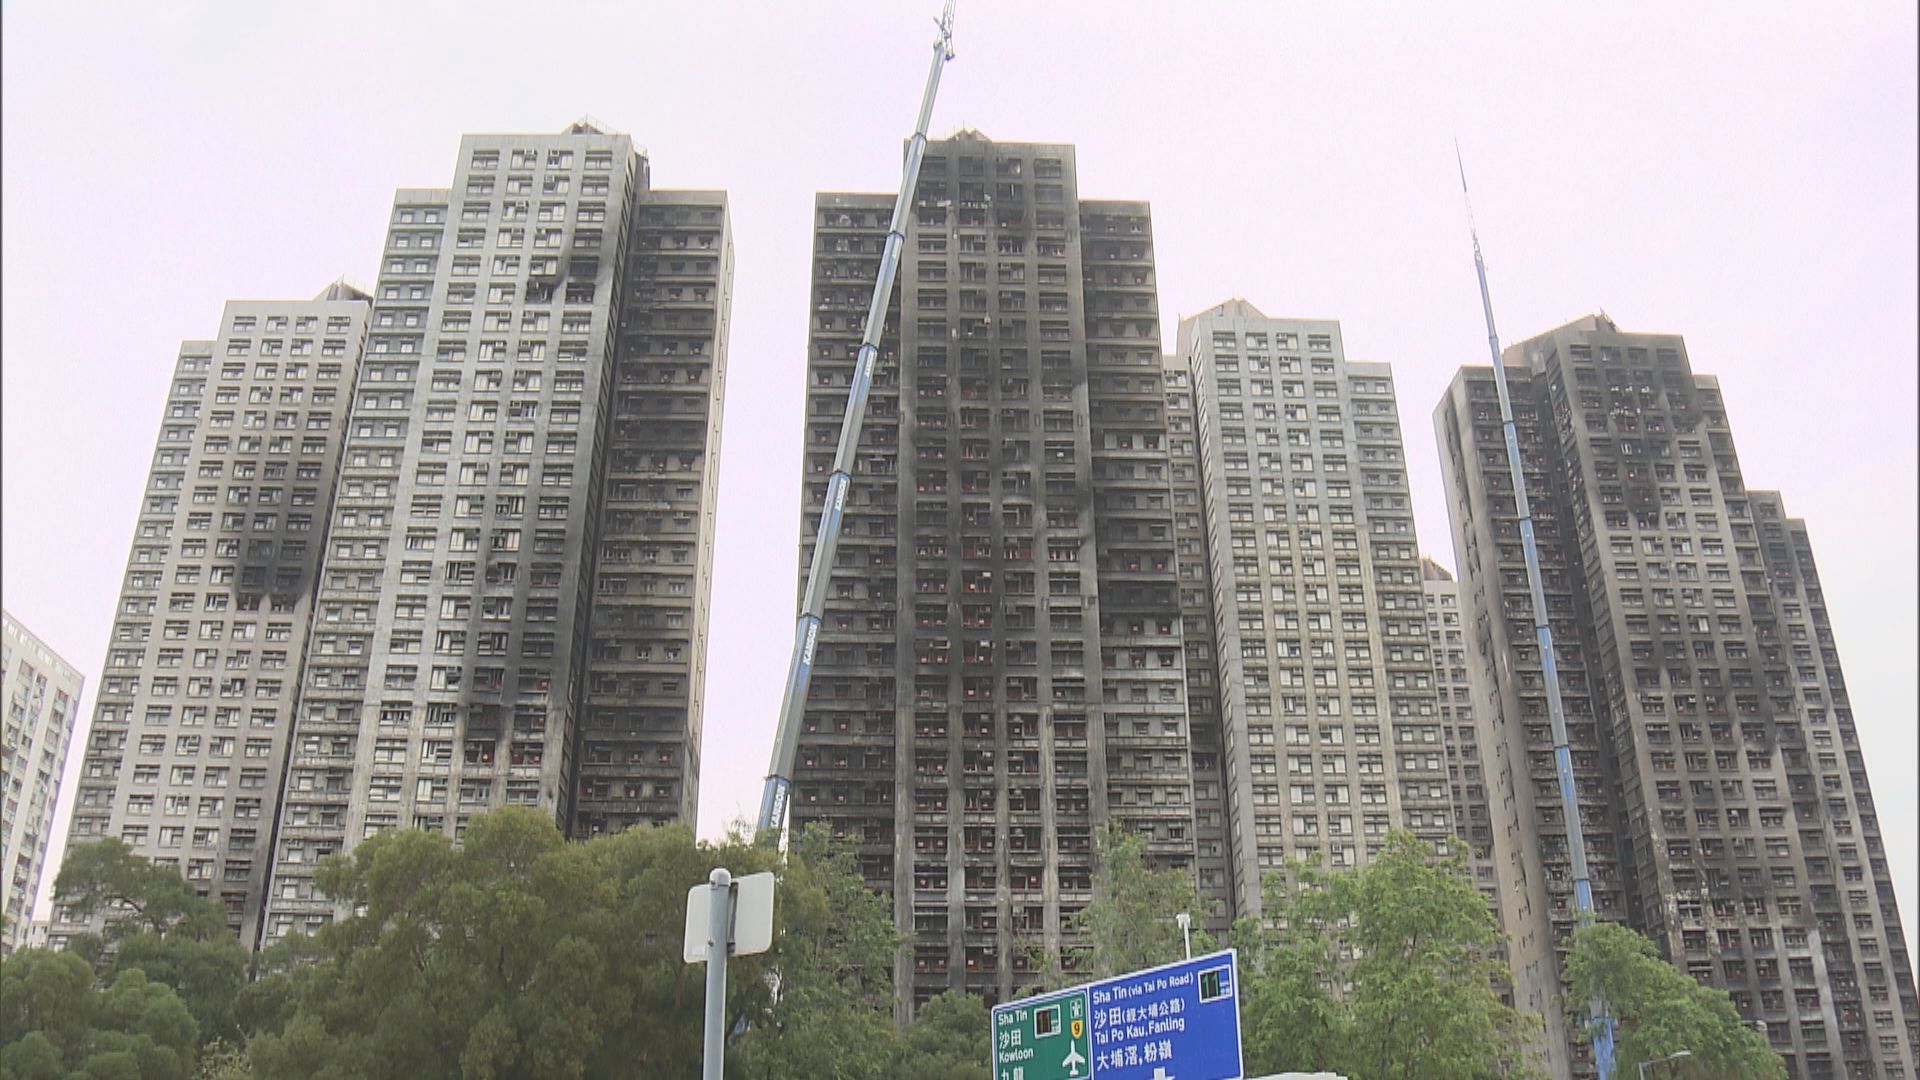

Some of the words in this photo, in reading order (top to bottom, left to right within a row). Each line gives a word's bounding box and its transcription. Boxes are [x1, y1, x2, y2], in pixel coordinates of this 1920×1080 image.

[1093, 990, 1110, 1005] Sha
[1112, 986, 1127, 1000] Tin
[1128, 985, 1142, 998] (via
[1144, 982, 1155, 993] Tai
[1157, 980, 1167, 991] Po
[1169, 972, 1193, 987] Road)
[1202, 972, 1219, 998] 11
[998, 1014, 1013, 1025] Sha
[1015, 1010, 1027, 1021] Tin
[1074, 1023, 1080, 1034] 9
[1095, 1030, 1108, 1045] Tai
[1111, 1028, 1123, 1042] Po
[999, 1028, 1021, 1049] 沙田
[999, 1048, 1034, 1064] Kowloon
